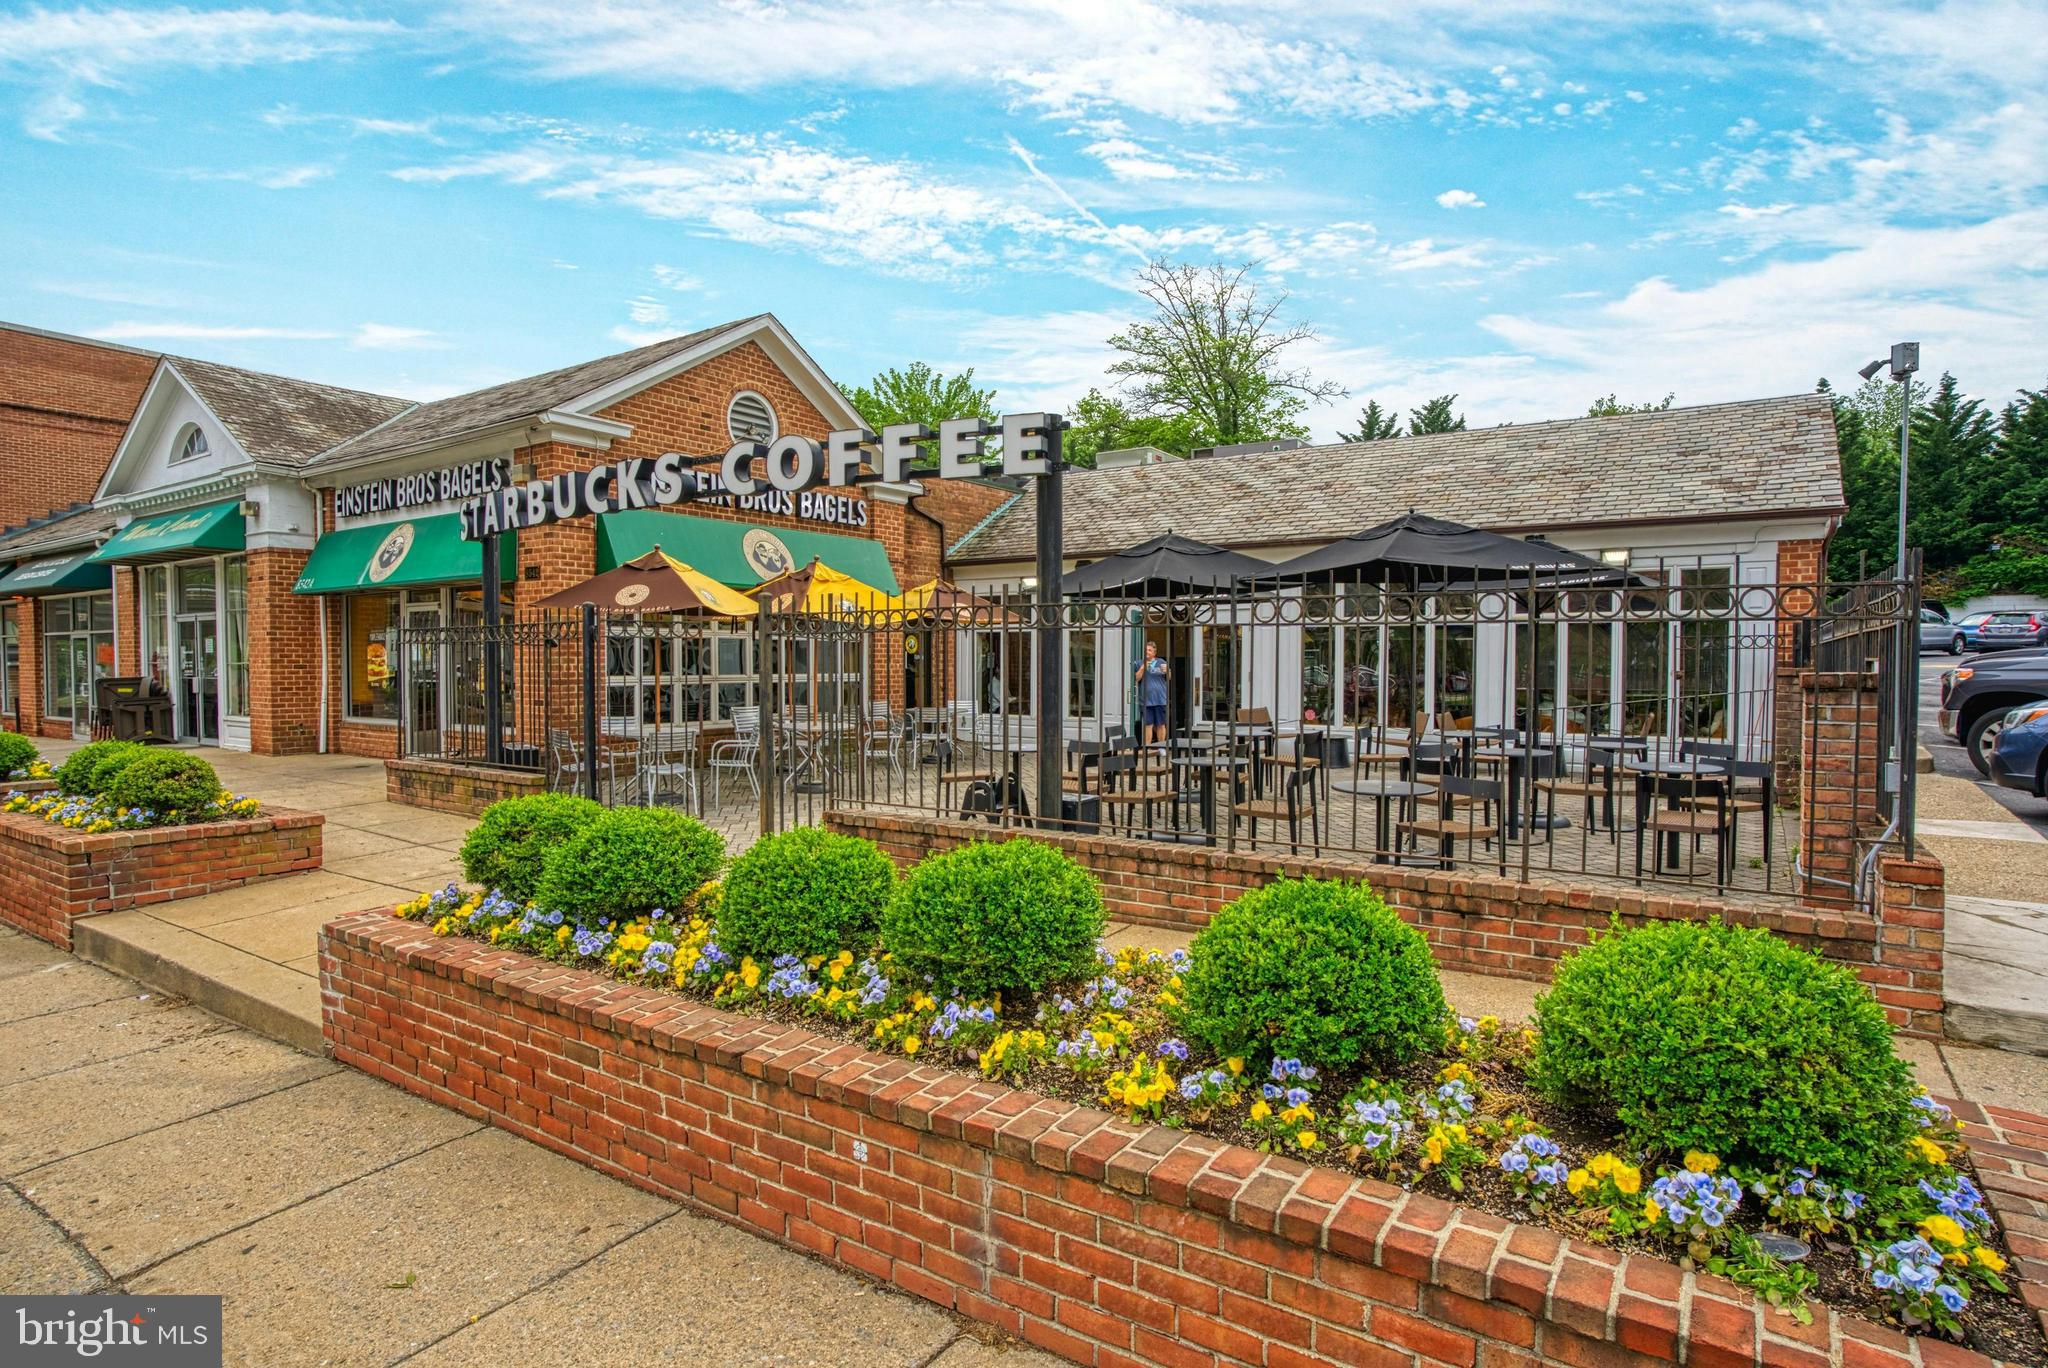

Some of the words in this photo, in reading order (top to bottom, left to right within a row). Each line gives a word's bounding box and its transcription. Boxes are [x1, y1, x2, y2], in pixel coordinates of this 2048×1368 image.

[335, 480, 391, 516] EINSTEIN
[396, 471, 435, 507] BROS
[440, 457, 502, 499] BAGELS
[460, 452, 684, 541] STARBUCKS
[721, 413, 1051, 496] COFFEE
[800, 491, 868, 527] BAGELS
